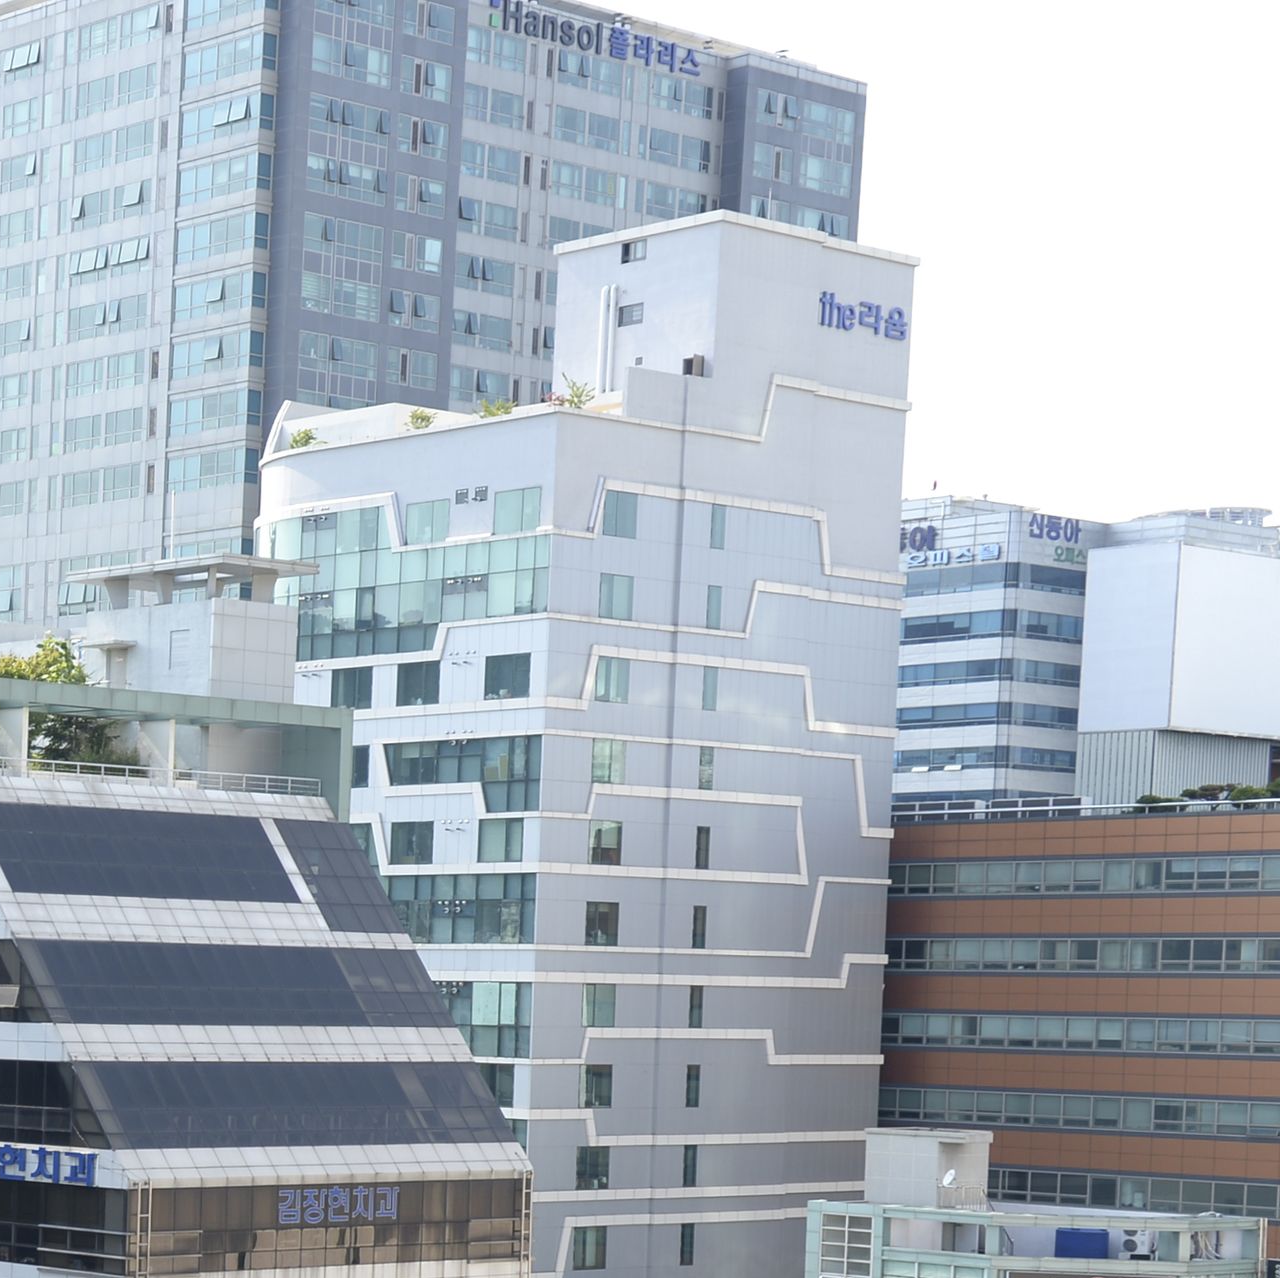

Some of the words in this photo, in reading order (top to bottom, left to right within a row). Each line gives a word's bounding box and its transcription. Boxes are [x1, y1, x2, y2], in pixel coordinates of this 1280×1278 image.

[503, 0, 603, 54] Hansol
[1029, 513, 1082, 544] 신동아
[278, 1186, 400, 1224] 김장현치과
